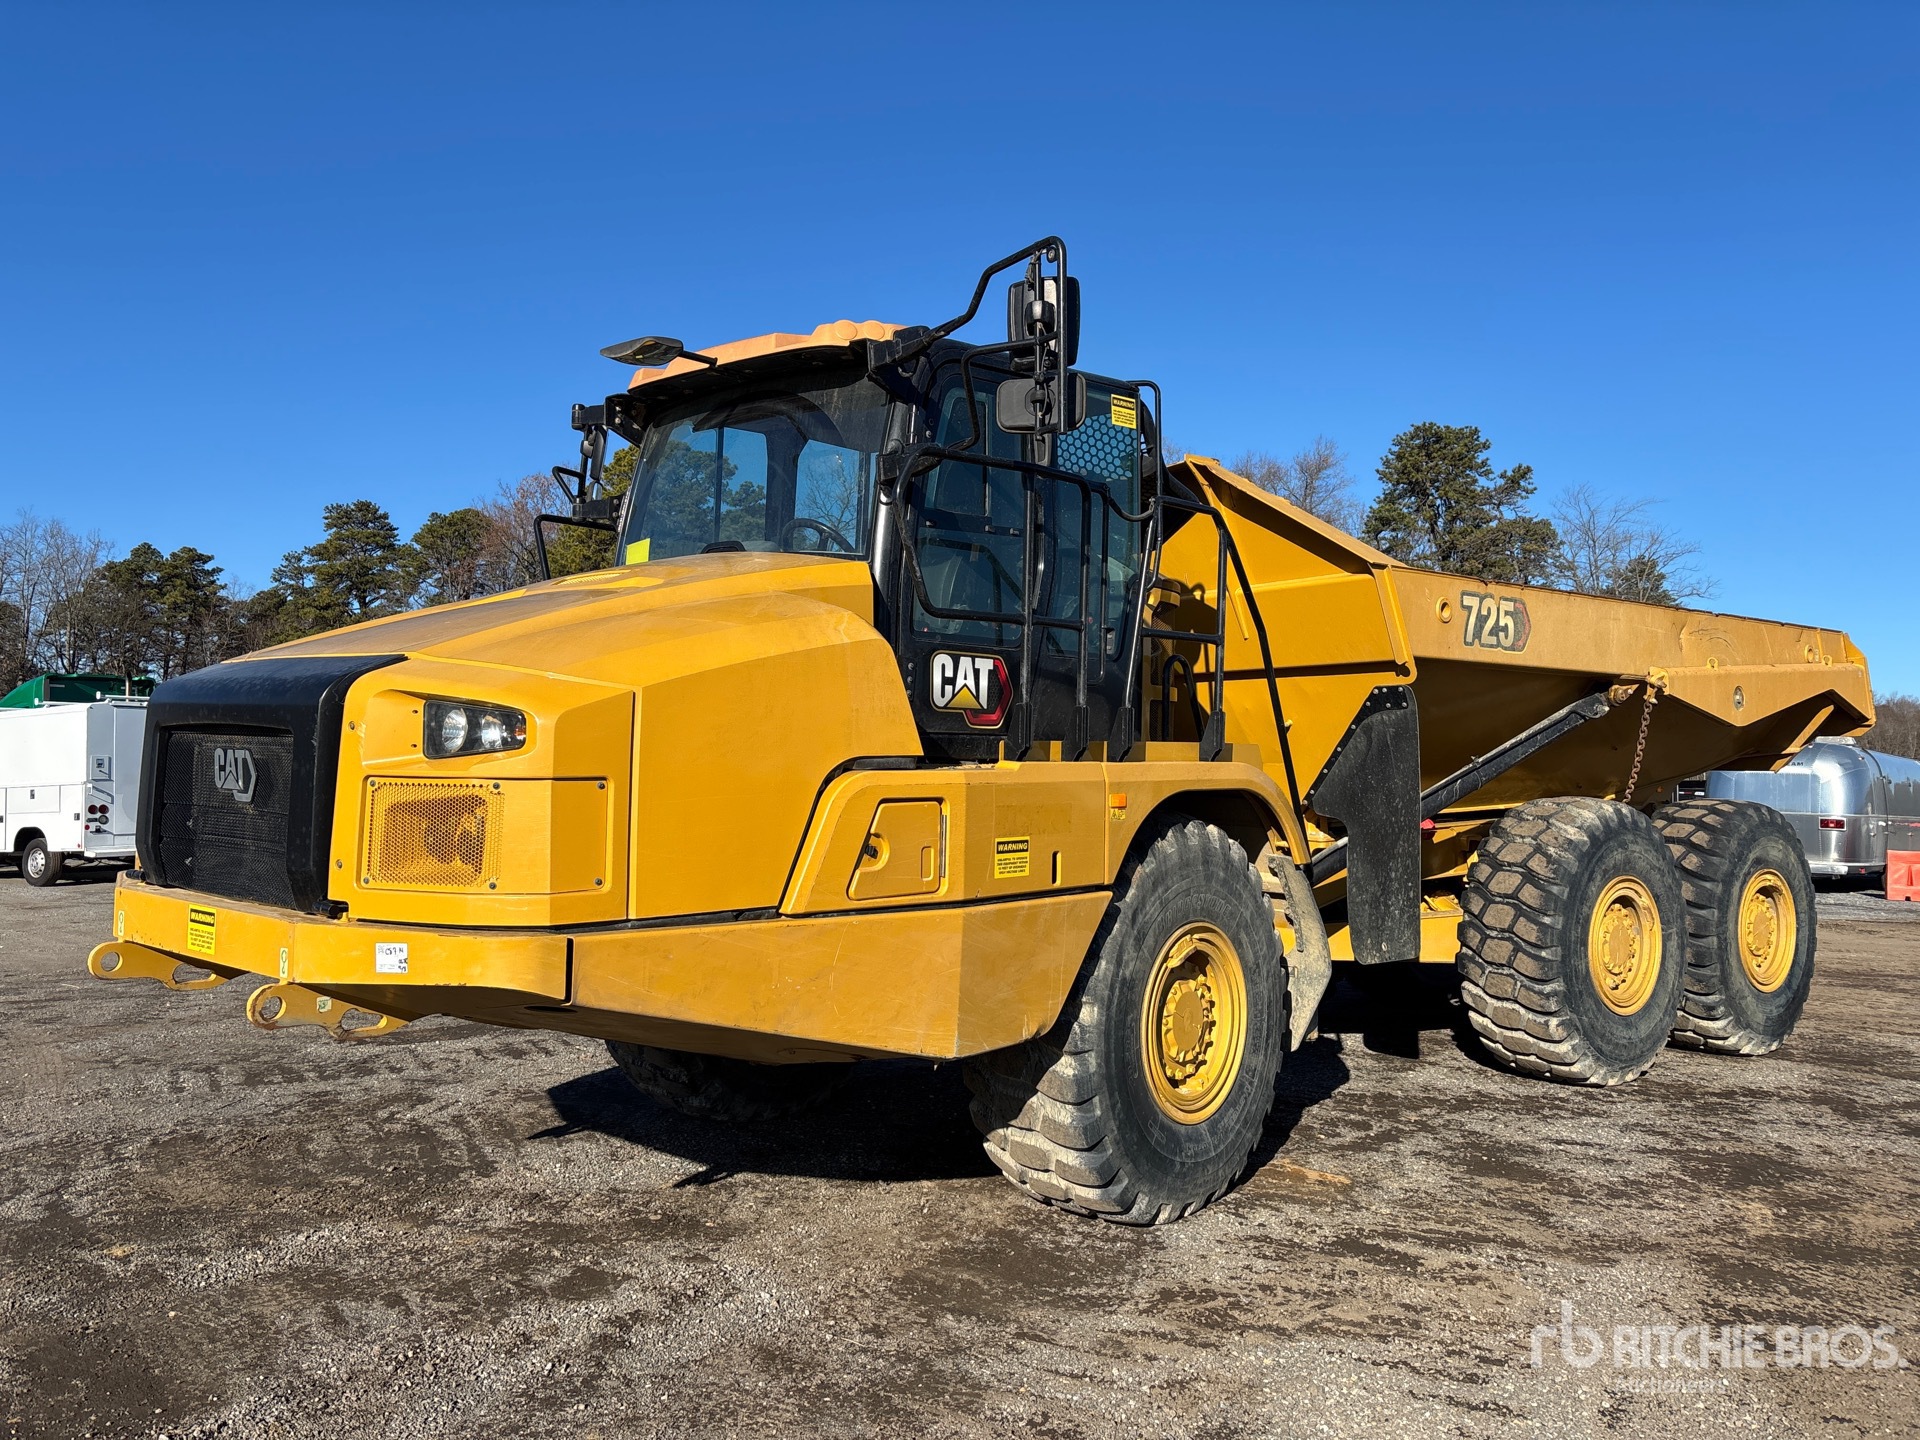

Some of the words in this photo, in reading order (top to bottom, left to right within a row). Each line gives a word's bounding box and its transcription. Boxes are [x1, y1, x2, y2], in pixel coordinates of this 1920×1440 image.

[1462, 595, 1515, 648] 725
[932, 653, 994, 710] CAT
[214, 747, 246, 791] CAT
[997, 842, 1029, 852] WARNING
[190, 911, 215, 924] WARNING
